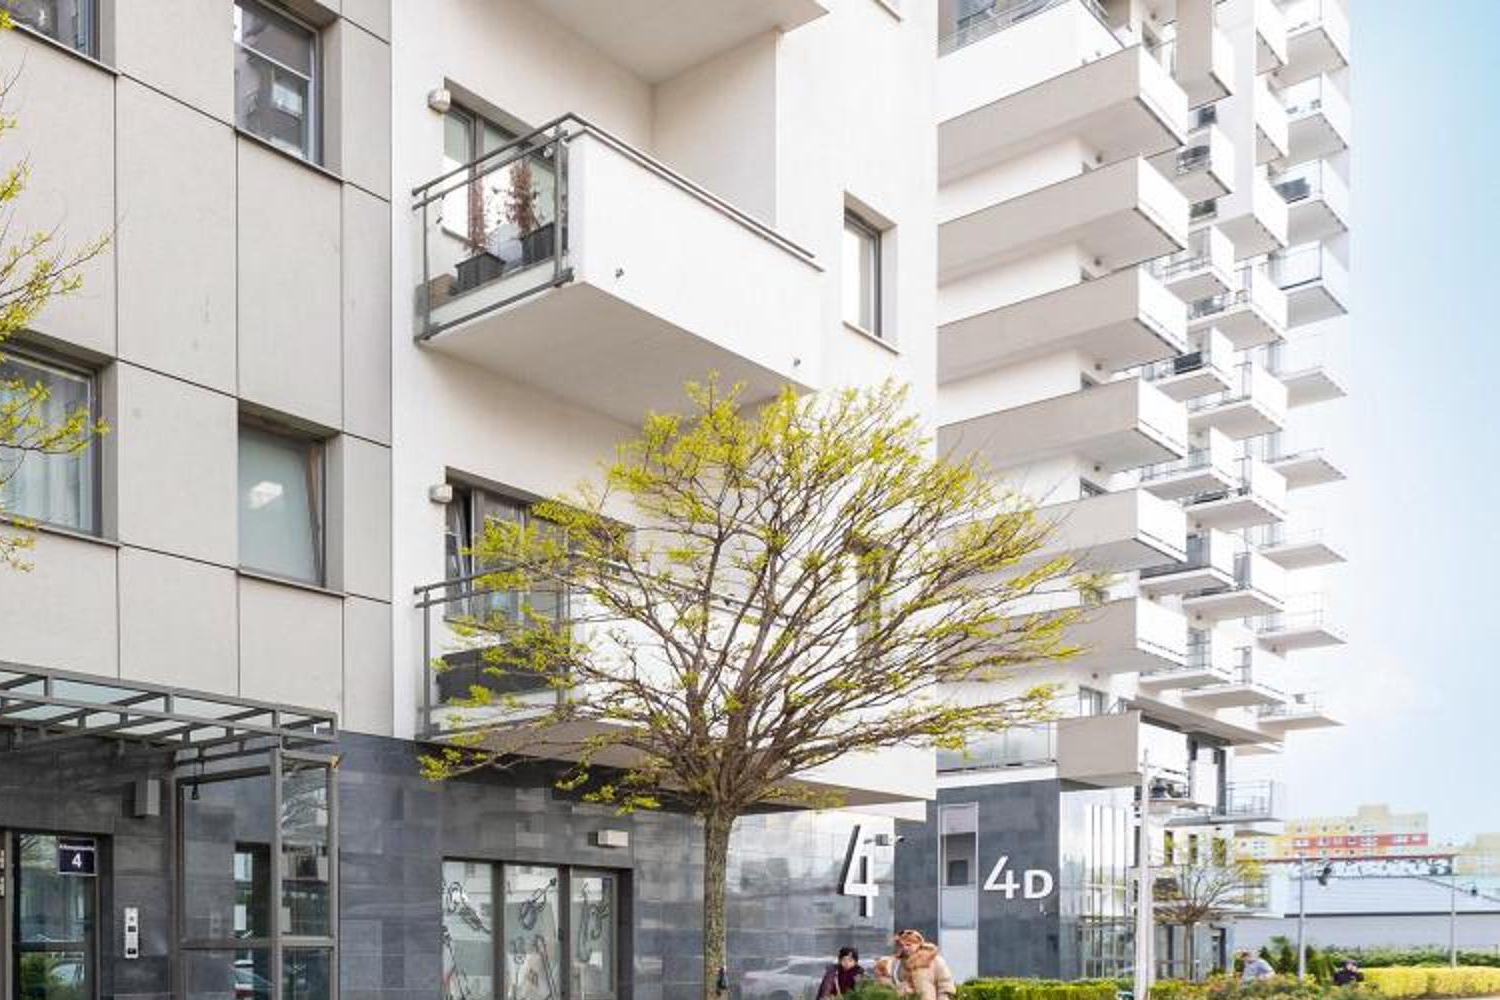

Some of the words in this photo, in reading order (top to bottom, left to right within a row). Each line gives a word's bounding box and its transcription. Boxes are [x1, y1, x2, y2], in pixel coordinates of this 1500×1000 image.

[71, 852, 83, 870] 4
[838, 823, 879, 918] 4
[983, 855, 1054, 899] 4D
